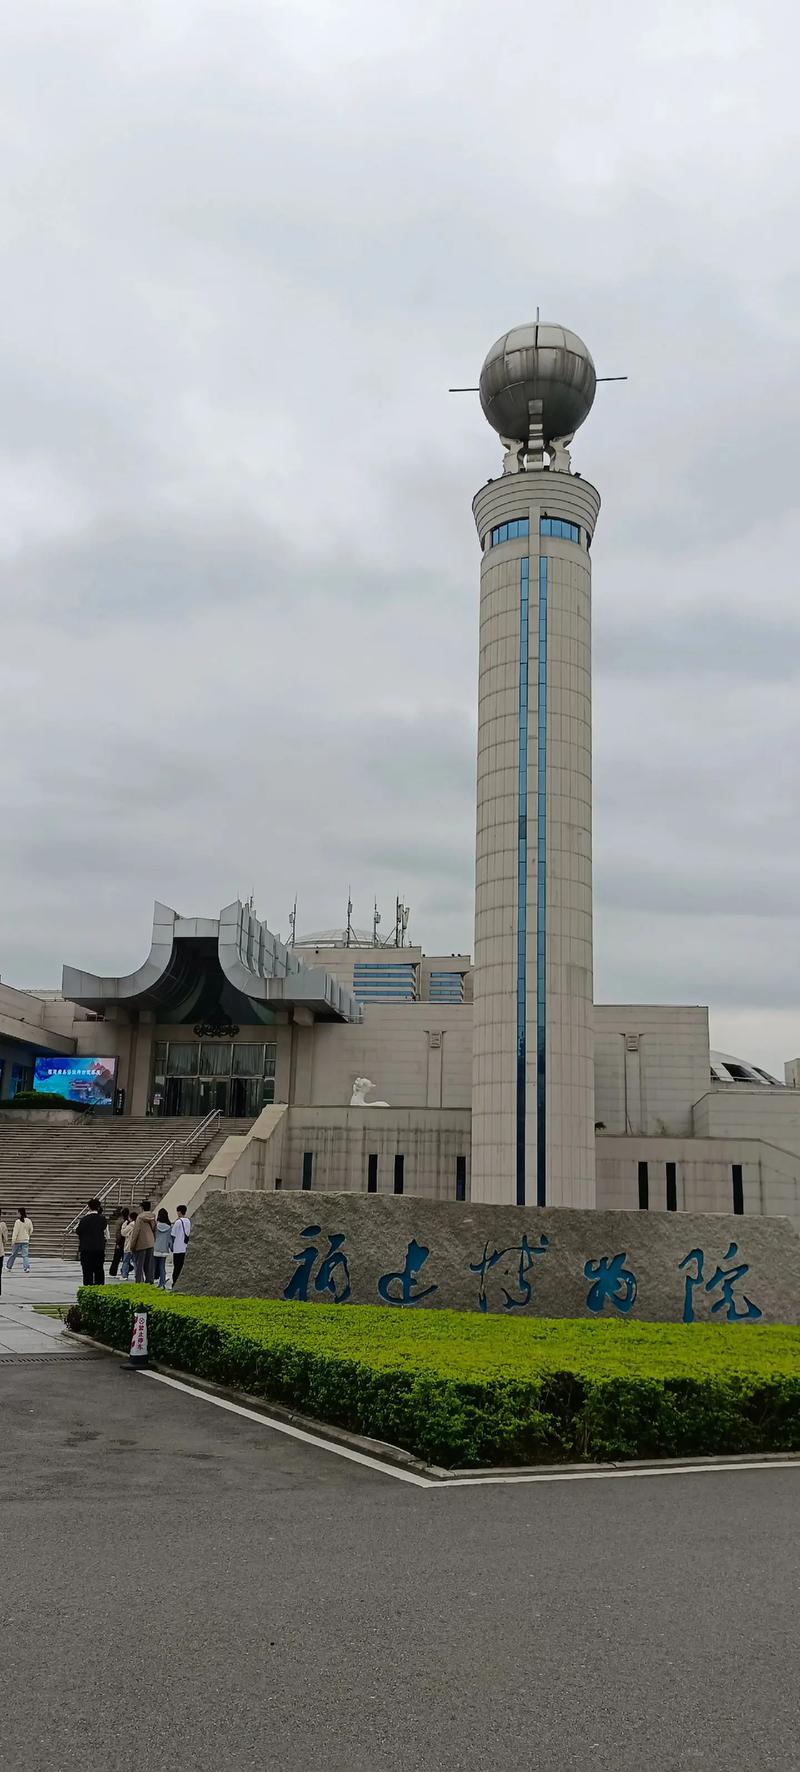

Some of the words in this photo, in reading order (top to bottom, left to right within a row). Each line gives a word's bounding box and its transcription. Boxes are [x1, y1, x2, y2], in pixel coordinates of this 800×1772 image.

[284, 1225, 763, 1323] 福建博物院
